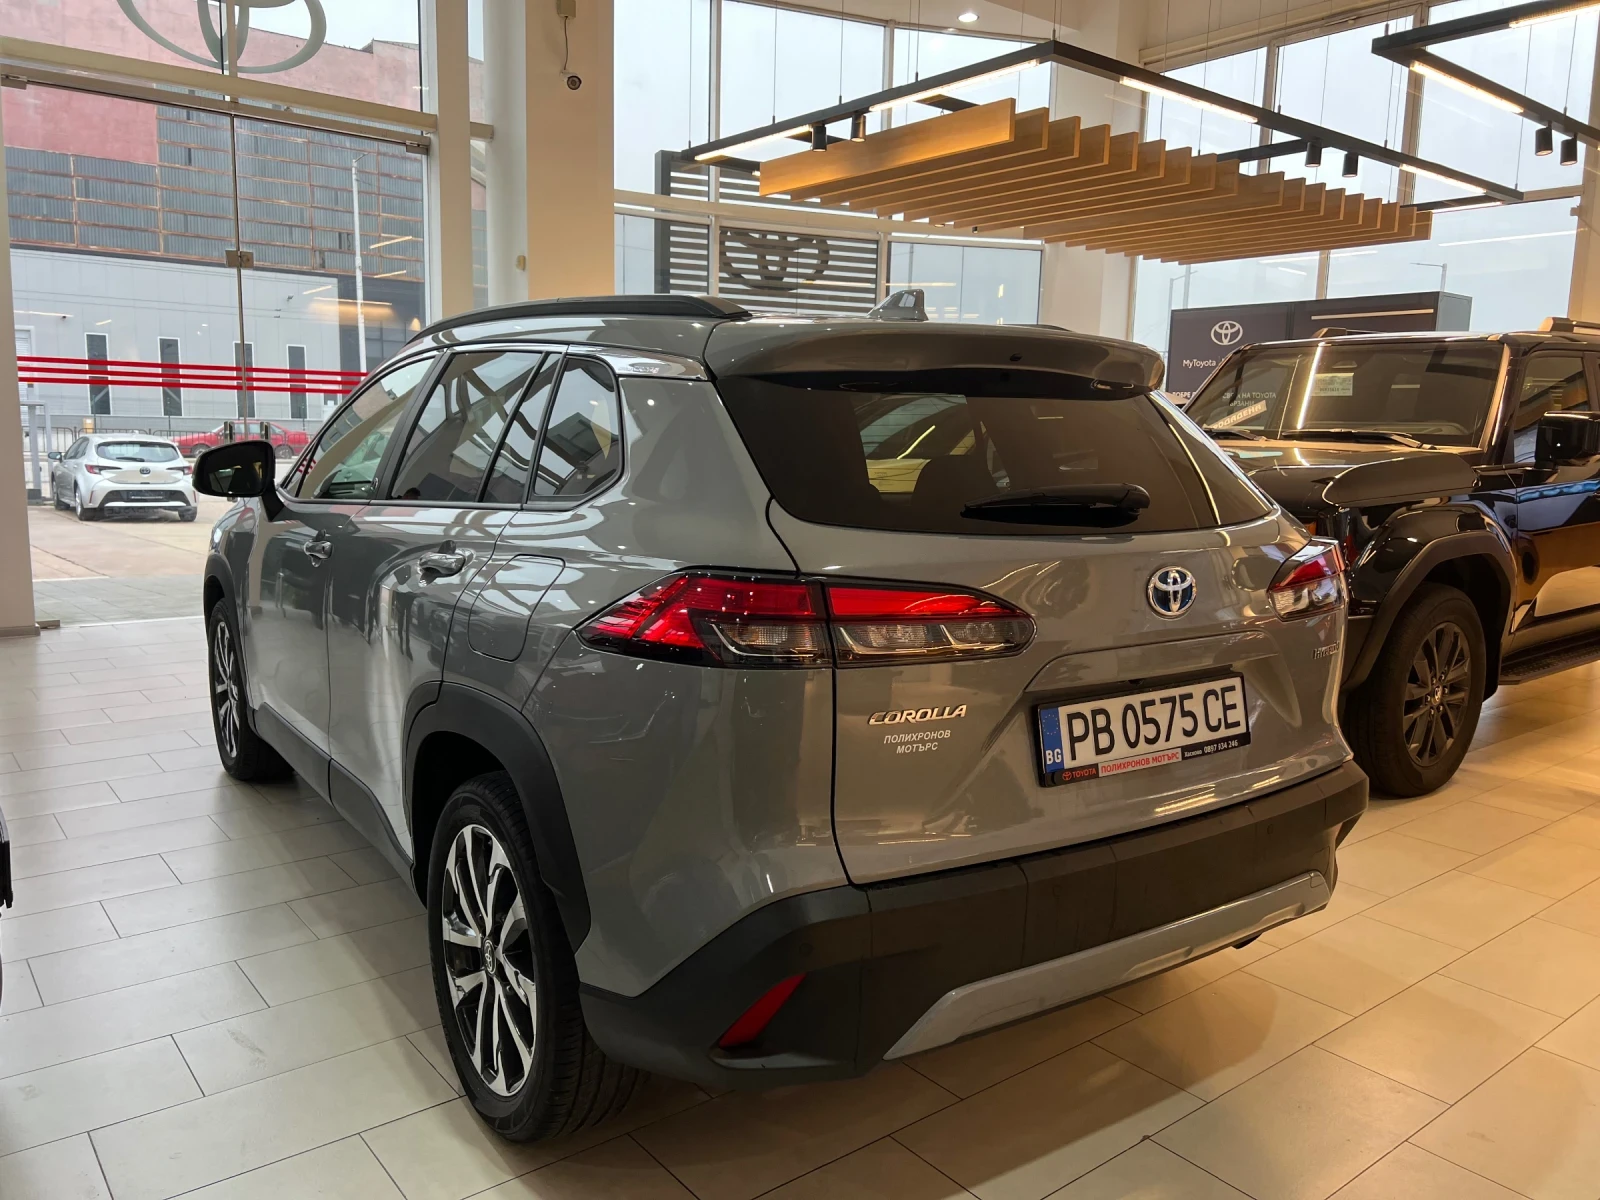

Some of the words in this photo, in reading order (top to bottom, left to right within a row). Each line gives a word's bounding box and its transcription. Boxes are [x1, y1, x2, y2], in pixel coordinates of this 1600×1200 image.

[1182, 358, 1216, 369] MyToyota
[868, 704, 967, 725] COROLLA
[1066, 708, 1115, 761] PB
[1121, 692, 1199, 749] 0575
[1203, 685, 1241, 733] CE
[883, 729, 951, 744] ПОЛИХРОНОВ
[896, 742, 939, 754] МОТЪРС
[1045, 748, 1062, 765] BG
[1101, 757, 1150, 774] ПОЛИХРОНОВ
[1151, 751, 1180, 765] МОТЪРС
[1072, 768, 1097, 779] TOYOTA
